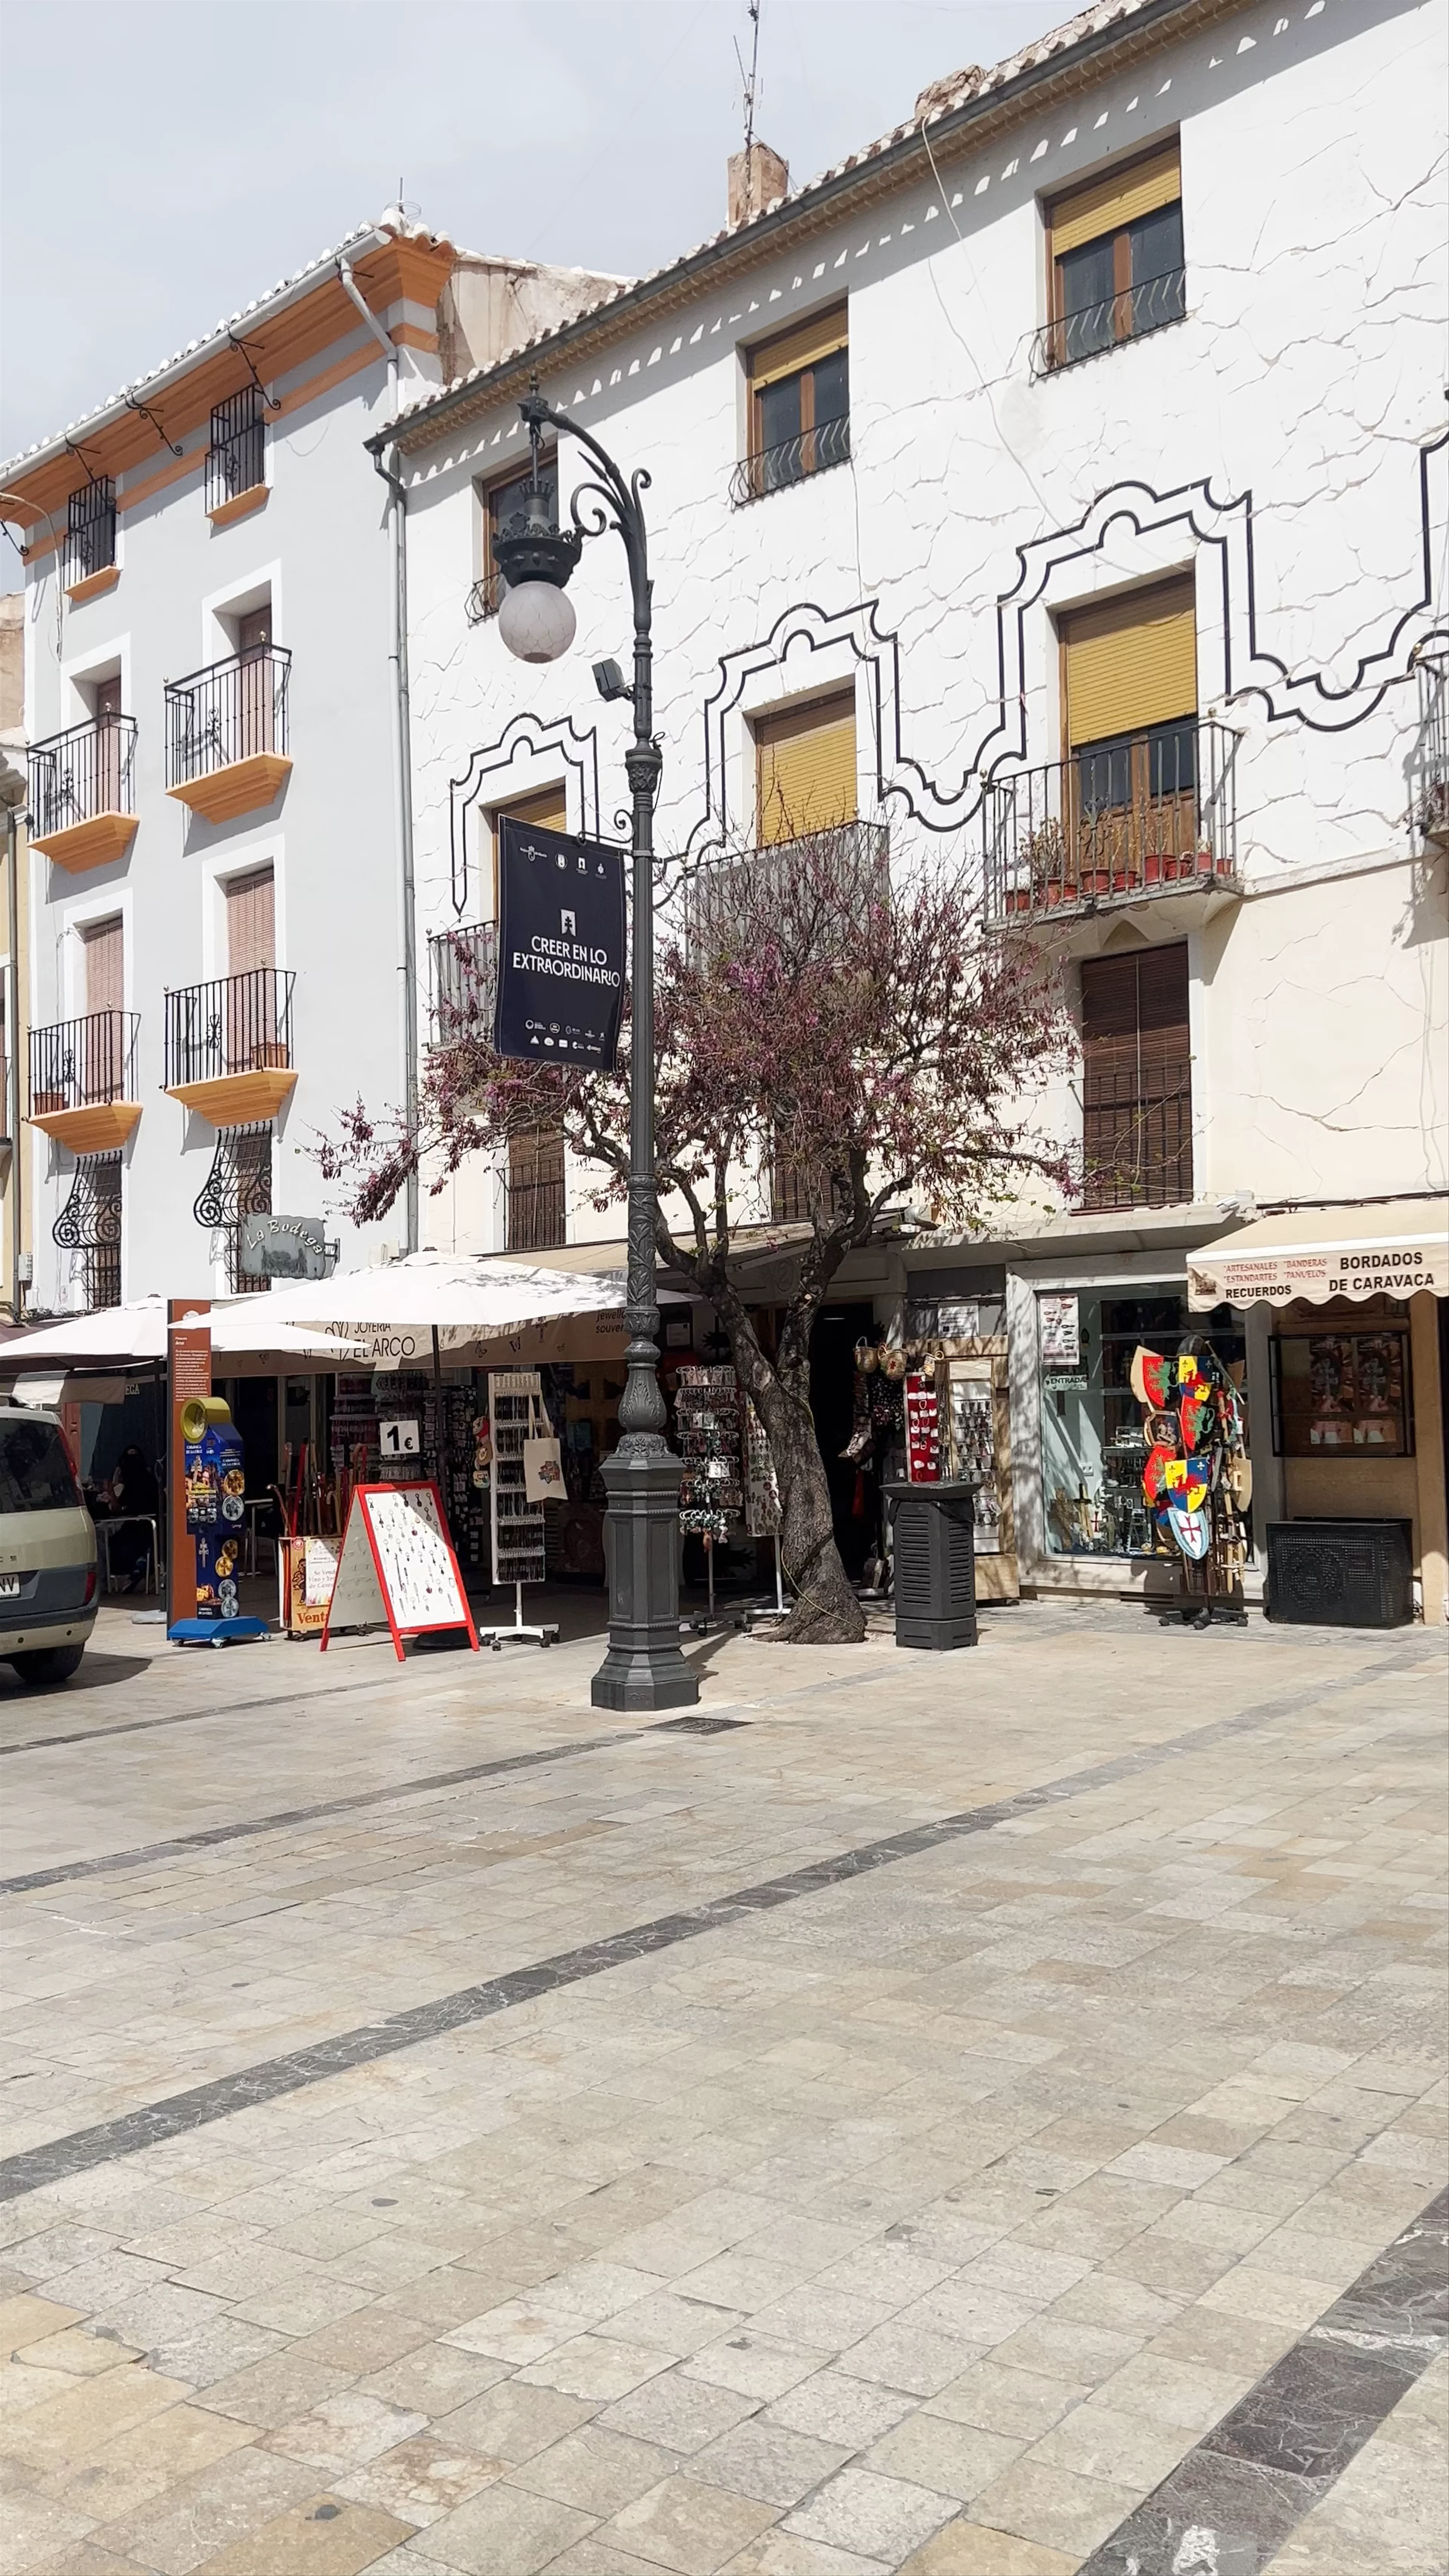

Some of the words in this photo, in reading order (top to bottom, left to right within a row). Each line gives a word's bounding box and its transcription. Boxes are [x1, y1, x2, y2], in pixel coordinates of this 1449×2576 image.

[531, 936, 571, 958] CREER
[573, 944, 587, 961] EN
[590, 948, 607, 965] LO
[513, 952, 620, 987] EXTRAORDINARIO
[246, 1230, 265, 1249] La
[1340, 1252, 1423, 1270] BORDADOS
[1226, 1285, 1291, 1298] RECUERDOS
[1329, 1278, 1347, 1292] DE
[1353, 1273, 1434, 1290] CARAVACA
[372, 1336, 415, 1358] ARCO
[387, 1425, 400, 1451] 1
[404, 1436, 414, 1450] €
